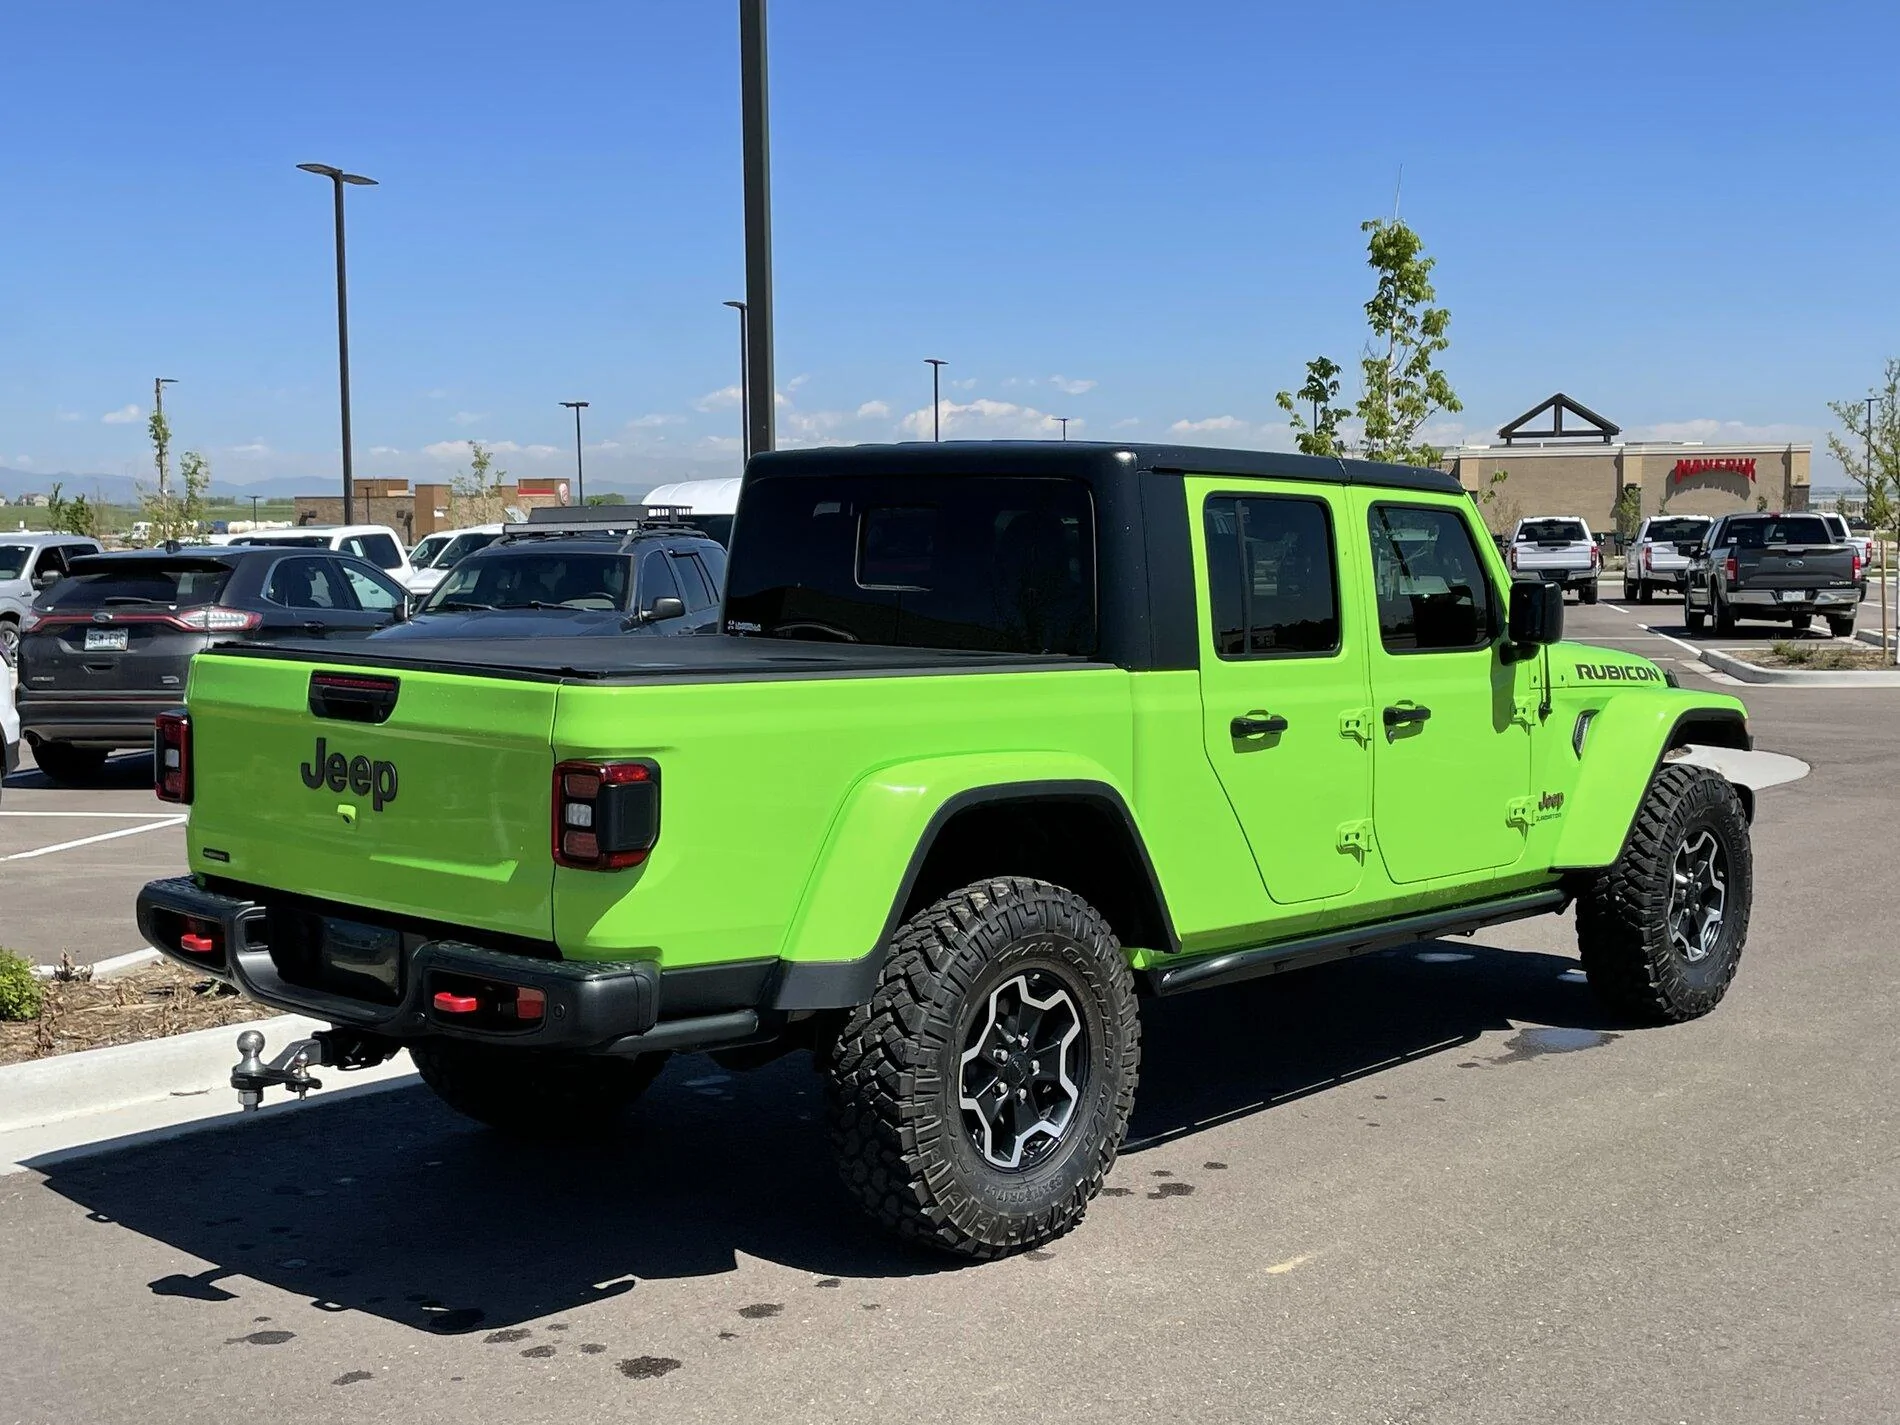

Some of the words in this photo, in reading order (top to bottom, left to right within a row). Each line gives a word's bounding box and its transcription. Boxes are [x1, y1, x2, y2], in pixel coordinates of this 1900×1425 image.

[1675, 458, 1756, 485] MAVERIK
[1575, 663, 1661, 681] RUBICON
[301, 737, 398, 811] Jeep
[1538, 791, 1564, 811] Jeep
